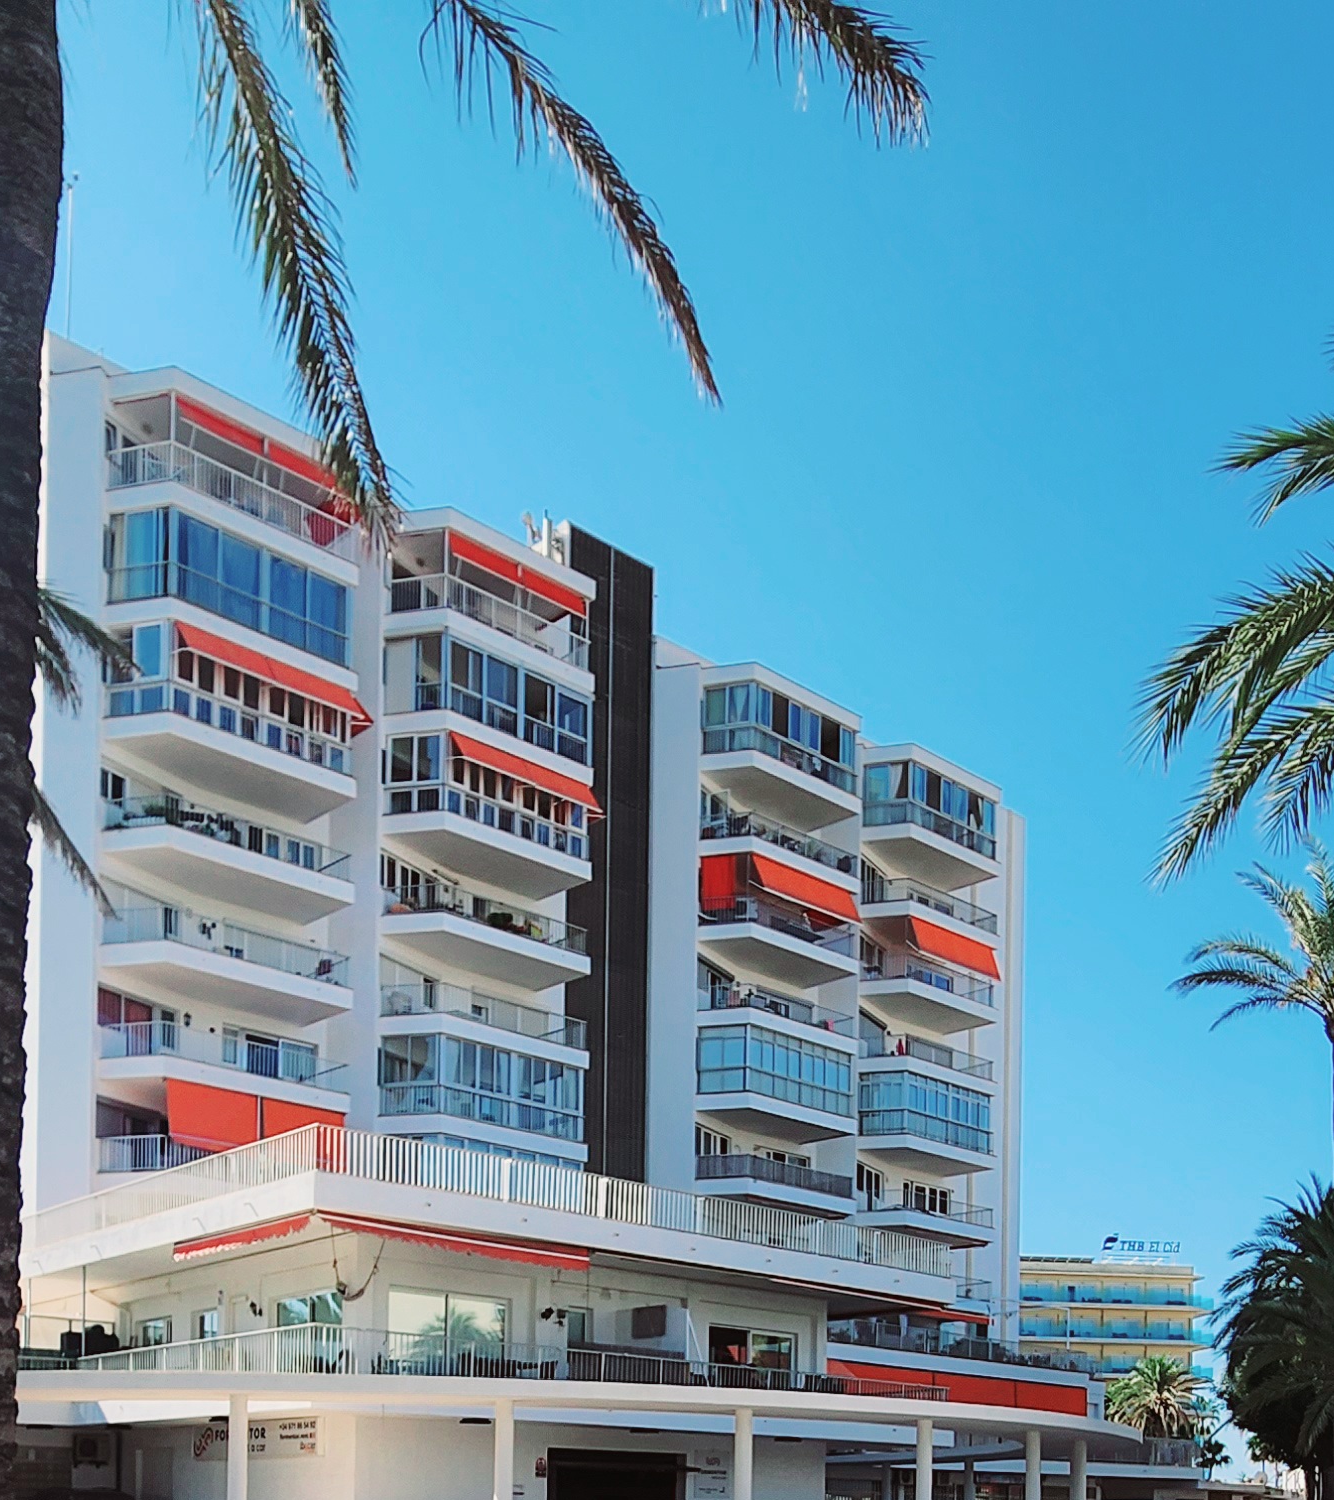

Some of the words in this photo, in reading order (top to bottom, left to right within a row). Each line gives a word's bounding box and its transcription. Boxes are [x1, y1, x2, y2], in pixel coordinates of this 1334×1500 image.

[1120, 1240, 1145, 1252] THB
[1148, 1240, 1160, 1253] El
[1163, 1240, 1181, 1253] Cid
